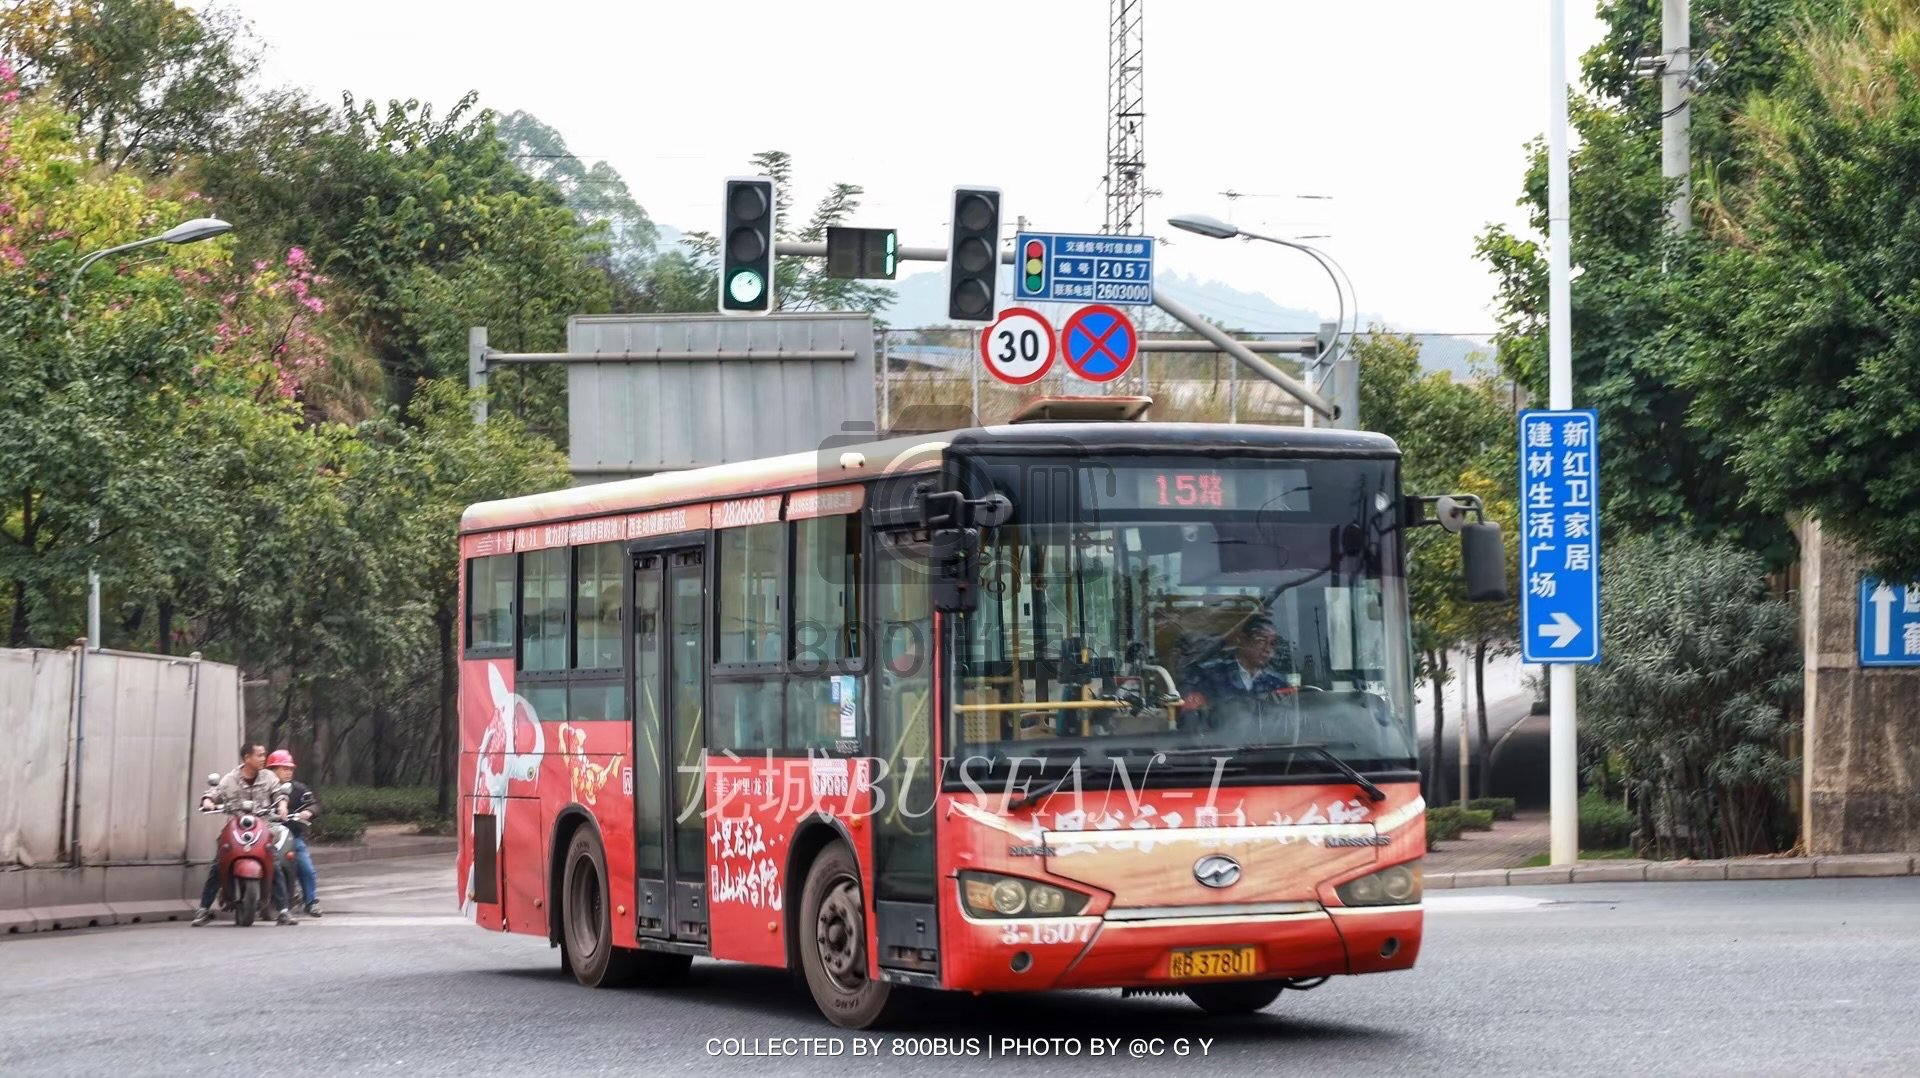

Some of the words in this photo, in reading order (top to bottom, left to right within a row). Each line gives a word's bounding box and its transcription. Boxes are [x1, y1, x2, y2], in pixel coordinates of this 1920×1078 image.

[1066, 241, 1144, 254] 交通信号灯信息牌
[1099, 261, 1147, 279] 2057
[1054, 284, 1094, 297] 联系电话
[1097, 284, 1149, 300] 2603000
[998, 329, 1039, 363] 30
[1155, 474, 1223, 506] 15路
[1562, 420, 1591, 571] 新红卫家居
[723, 497, 765, 528] 2826688
[1527, 421, 1557, 599] 建材生活广场
[710, 815, 766, 861] 十里龙江
[1001, 922, 1092, 945] 3-1507
